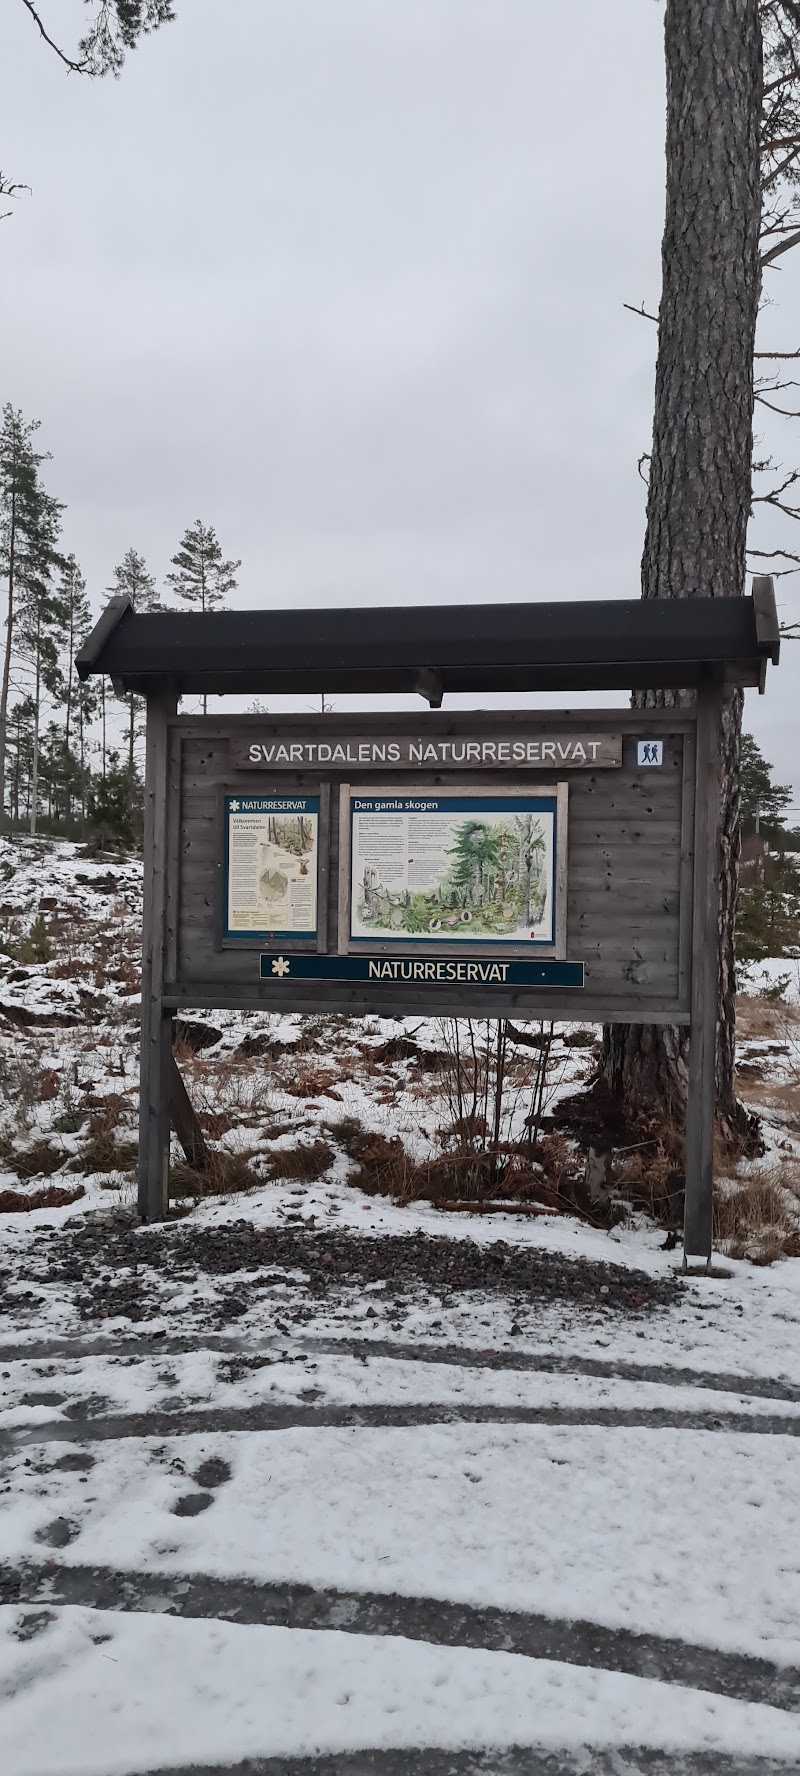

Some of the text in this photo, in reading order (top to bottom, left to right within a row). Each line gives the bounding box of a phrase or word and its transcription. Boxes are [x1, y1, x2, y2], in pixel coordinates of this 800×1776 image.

[248, 741, 602, 763] SVARTDALENS NATURRESERVAT
[241, 801, 307, 809] NATURRESERVAT
[354, 800, 438, 811] Den gamla skogen
[368, 960, 510, 982] NATURRESERVAT
